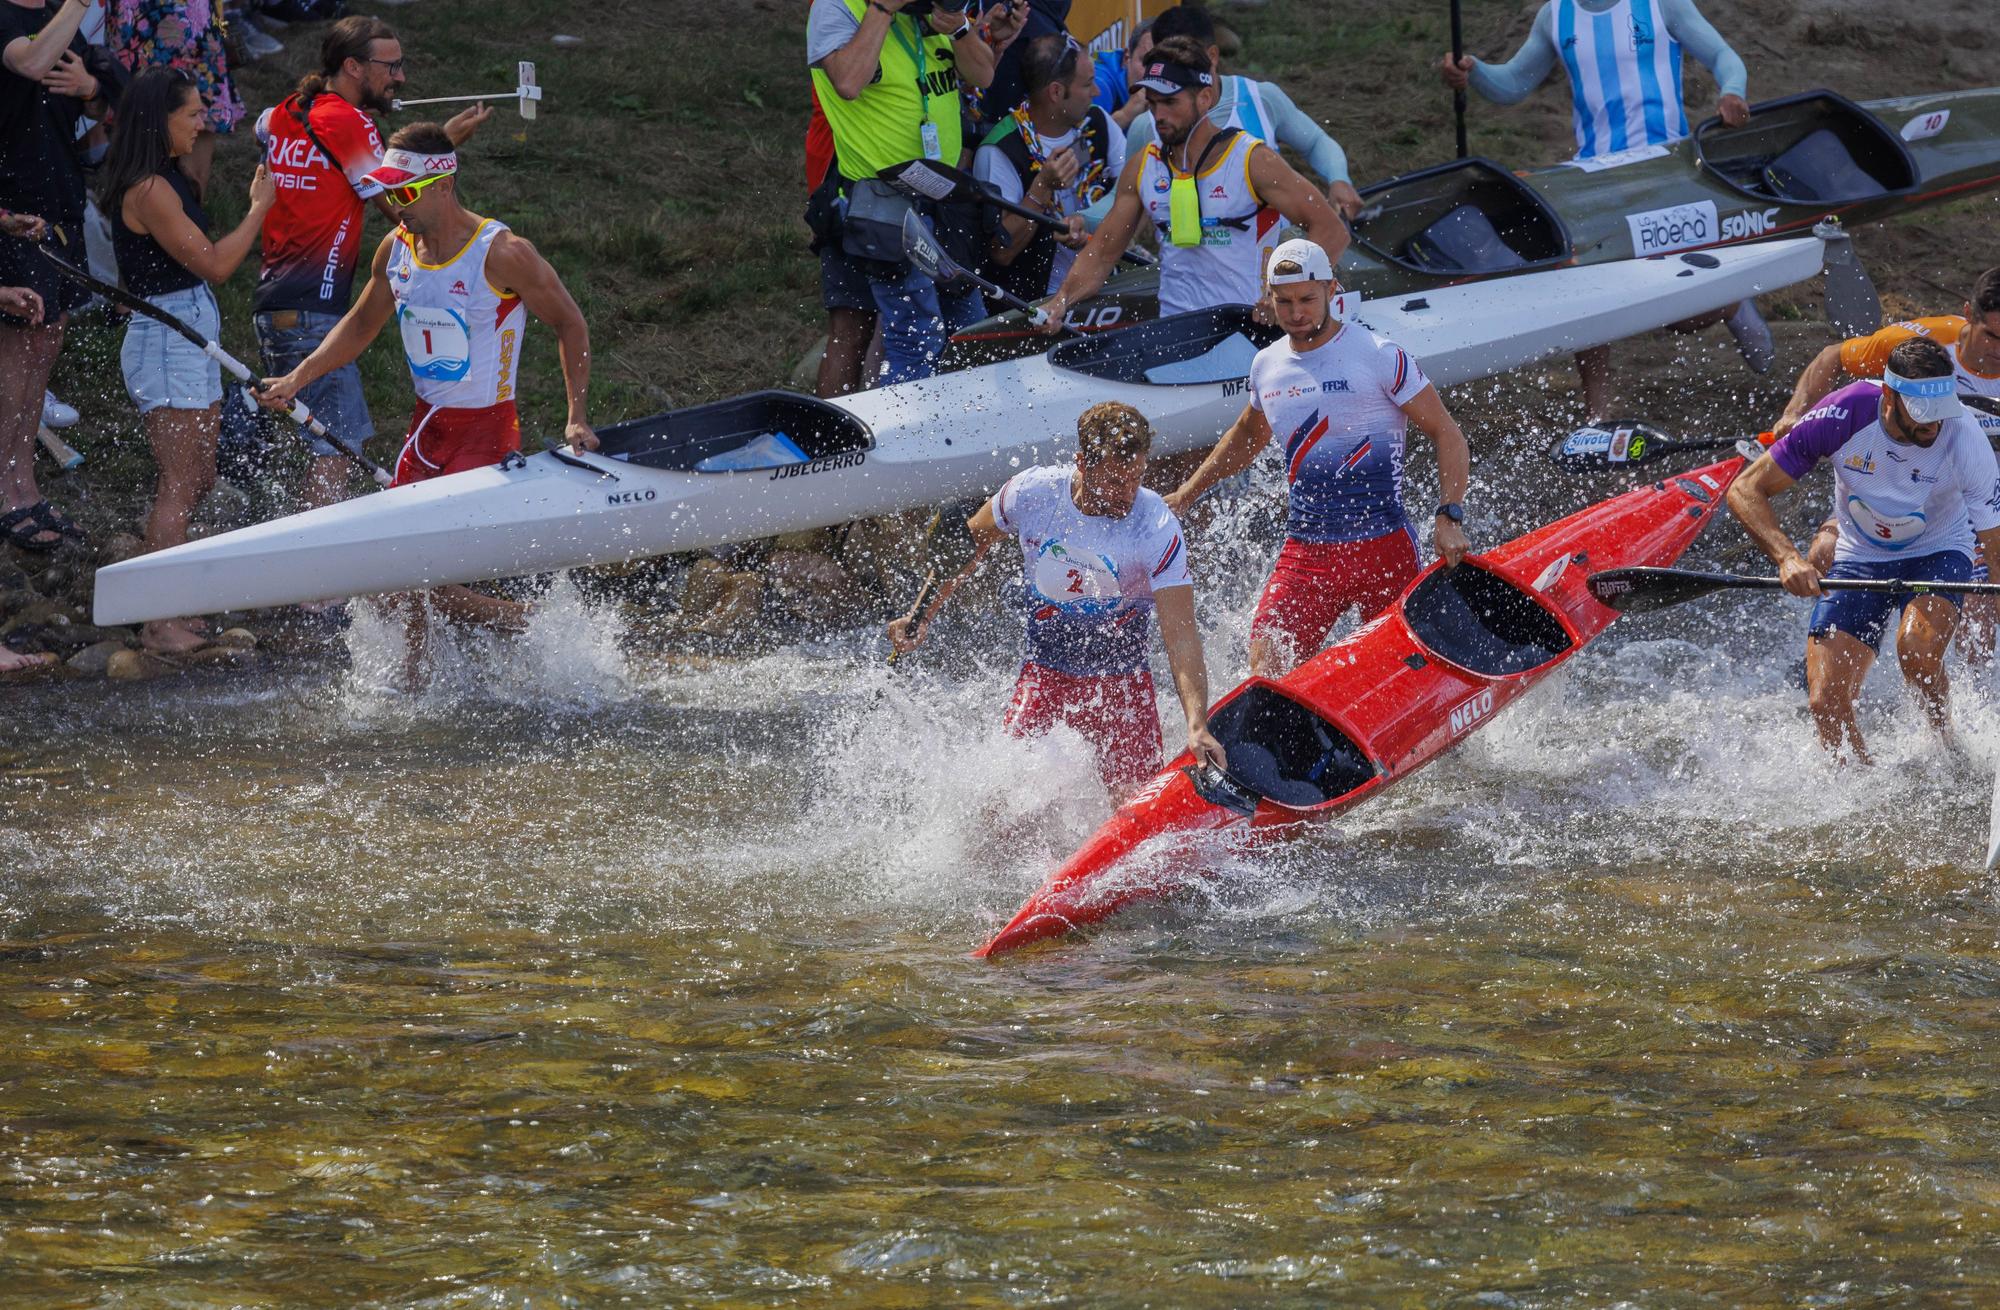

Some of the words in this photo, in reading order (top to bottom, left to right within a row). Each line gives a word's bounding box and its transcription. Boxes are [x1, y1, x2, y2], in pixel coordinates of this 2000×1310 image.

[267, 134, 330, 171] RKEA
[1720, 207, 1781, 241] SONIC
[1335, 295, 1345, 315] 1
[421, 328, 433, 355] 1
[1321, 380, 1350, 392] FFCK
[1571, 434, 1610, 447] Silvota
[769, 452, 866, 481] JJBECERRO
[1874, 523, 1893, 540] 3
[1066, 568, 1084, 594] 2
[1450, 691, 1492, 735] NELO
